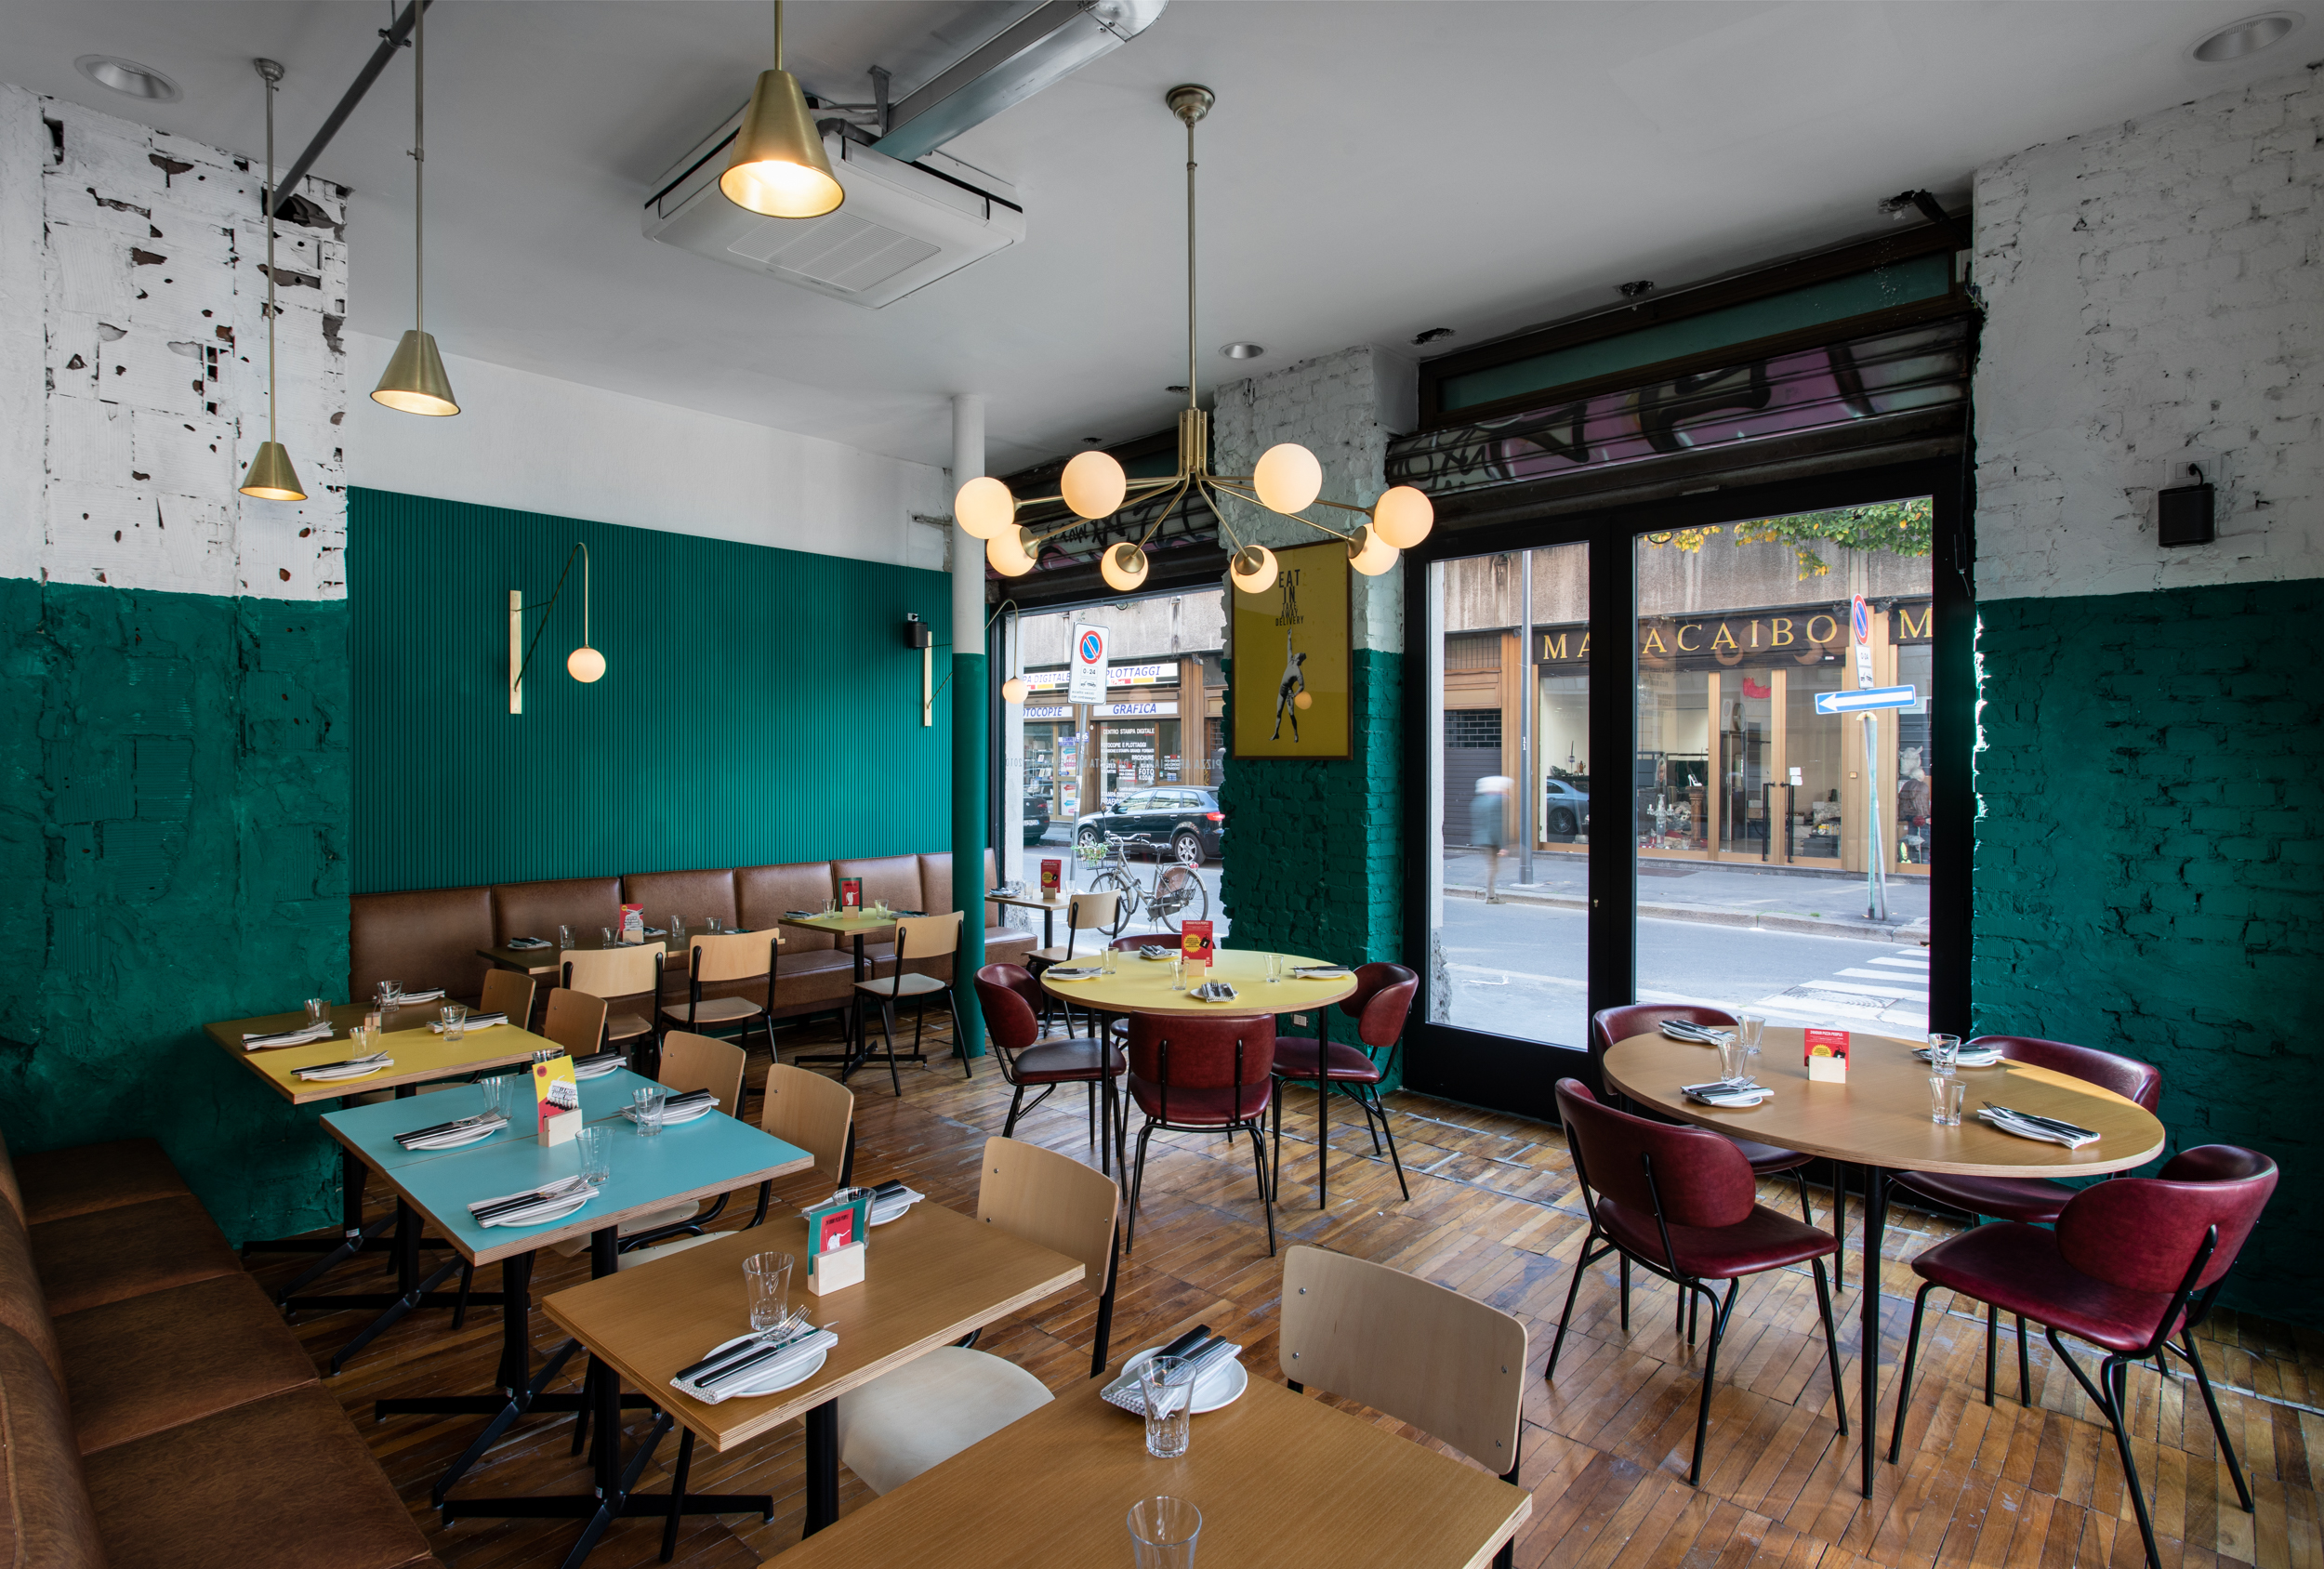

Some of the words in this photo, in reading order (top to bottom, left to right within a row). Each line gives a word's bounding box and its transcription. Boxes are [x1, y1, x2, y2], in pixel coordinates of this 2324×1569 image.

[1279, 569, 1301, 588] EAT
[1284, 586, 1295, 603] IN
[1282, 601, 1297, 611] TAKE
[1281, 609, 1299, 618] AWAY
[1275, 615, 1304, 626] DELIVERY
[1543, 614, 1838, 659] MAACAIBO
[1034, 672, 1070, 683] DIGITALE
[1113, 703, 1156, 715] GRAFICA
